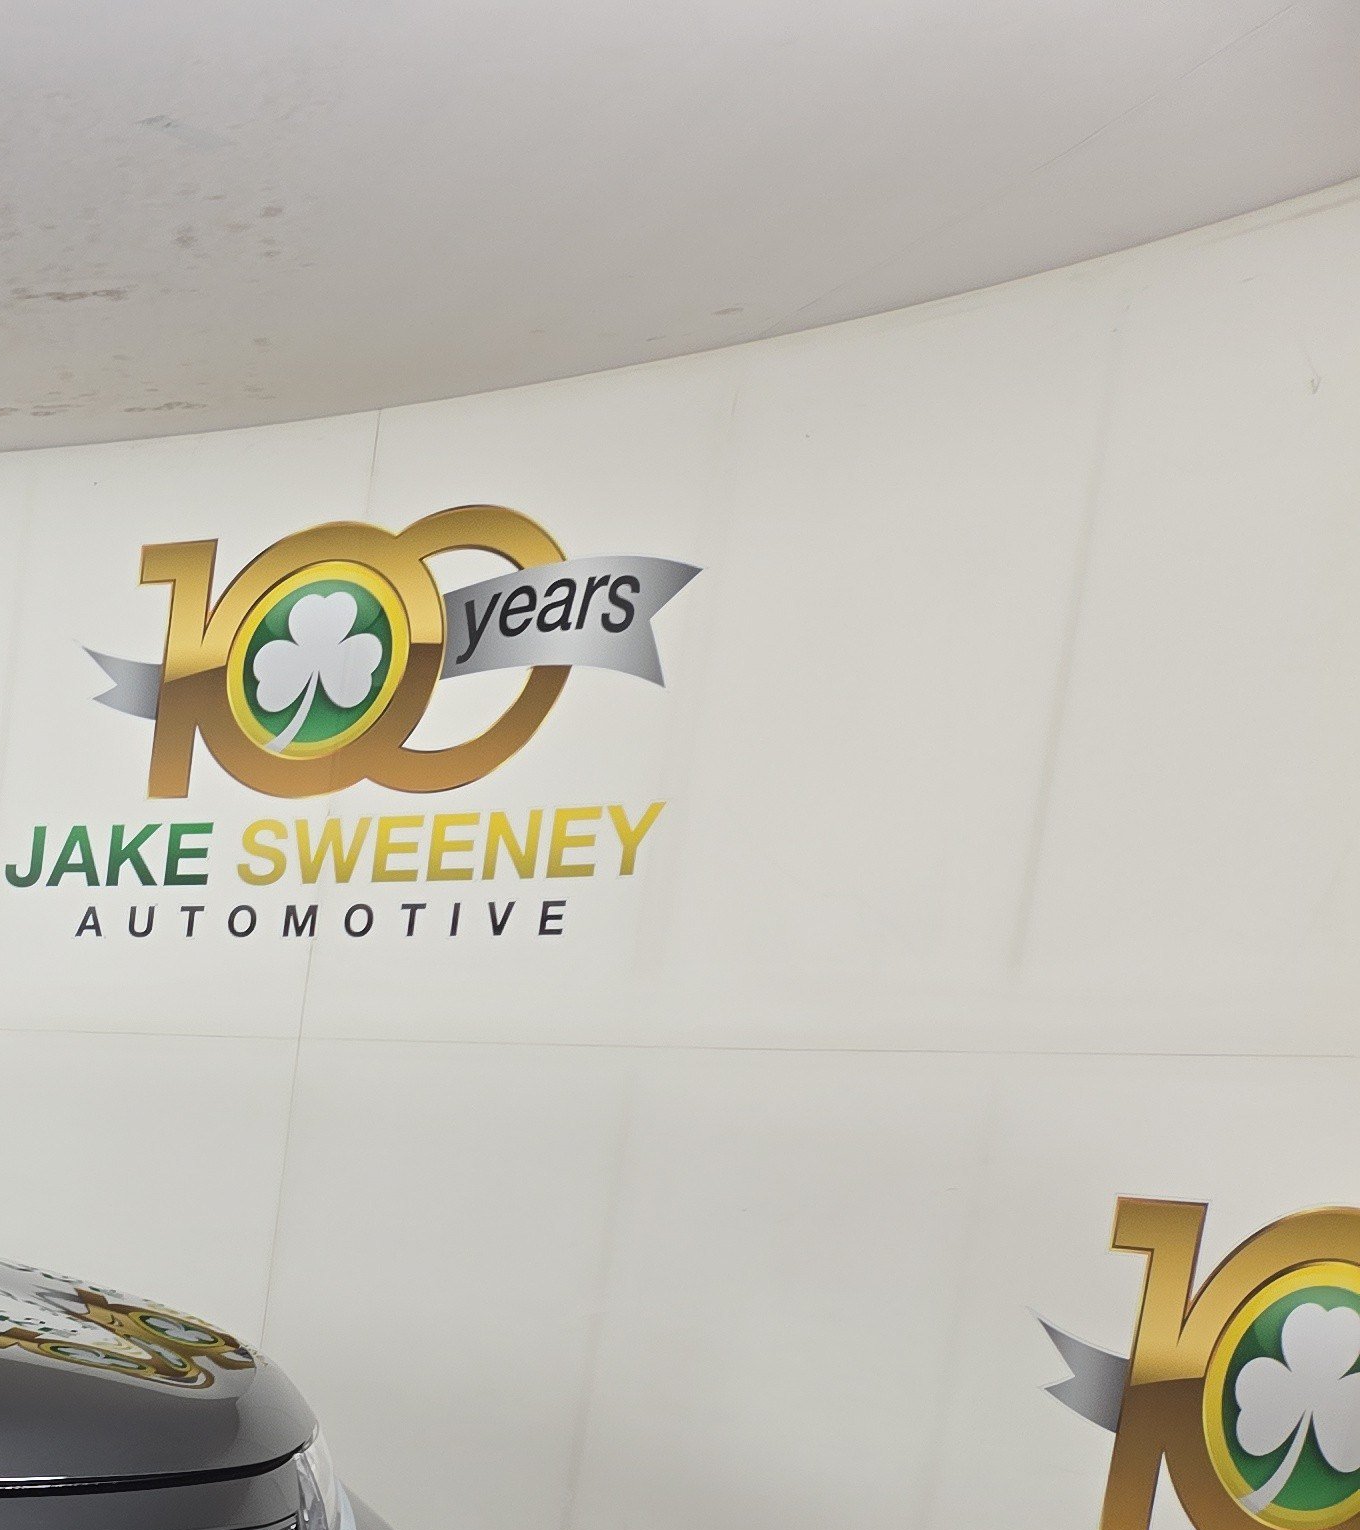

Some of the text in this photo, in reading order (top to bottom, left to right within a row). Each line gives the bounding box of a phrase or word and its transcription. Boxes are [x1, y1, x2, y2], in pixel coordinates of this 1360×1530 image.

[139, 504, 641, 800] 100 years
[5, 801, 666, 888] JAKE SWEENEY
[75, 899, 568, 938] AUTOMOTIVE
